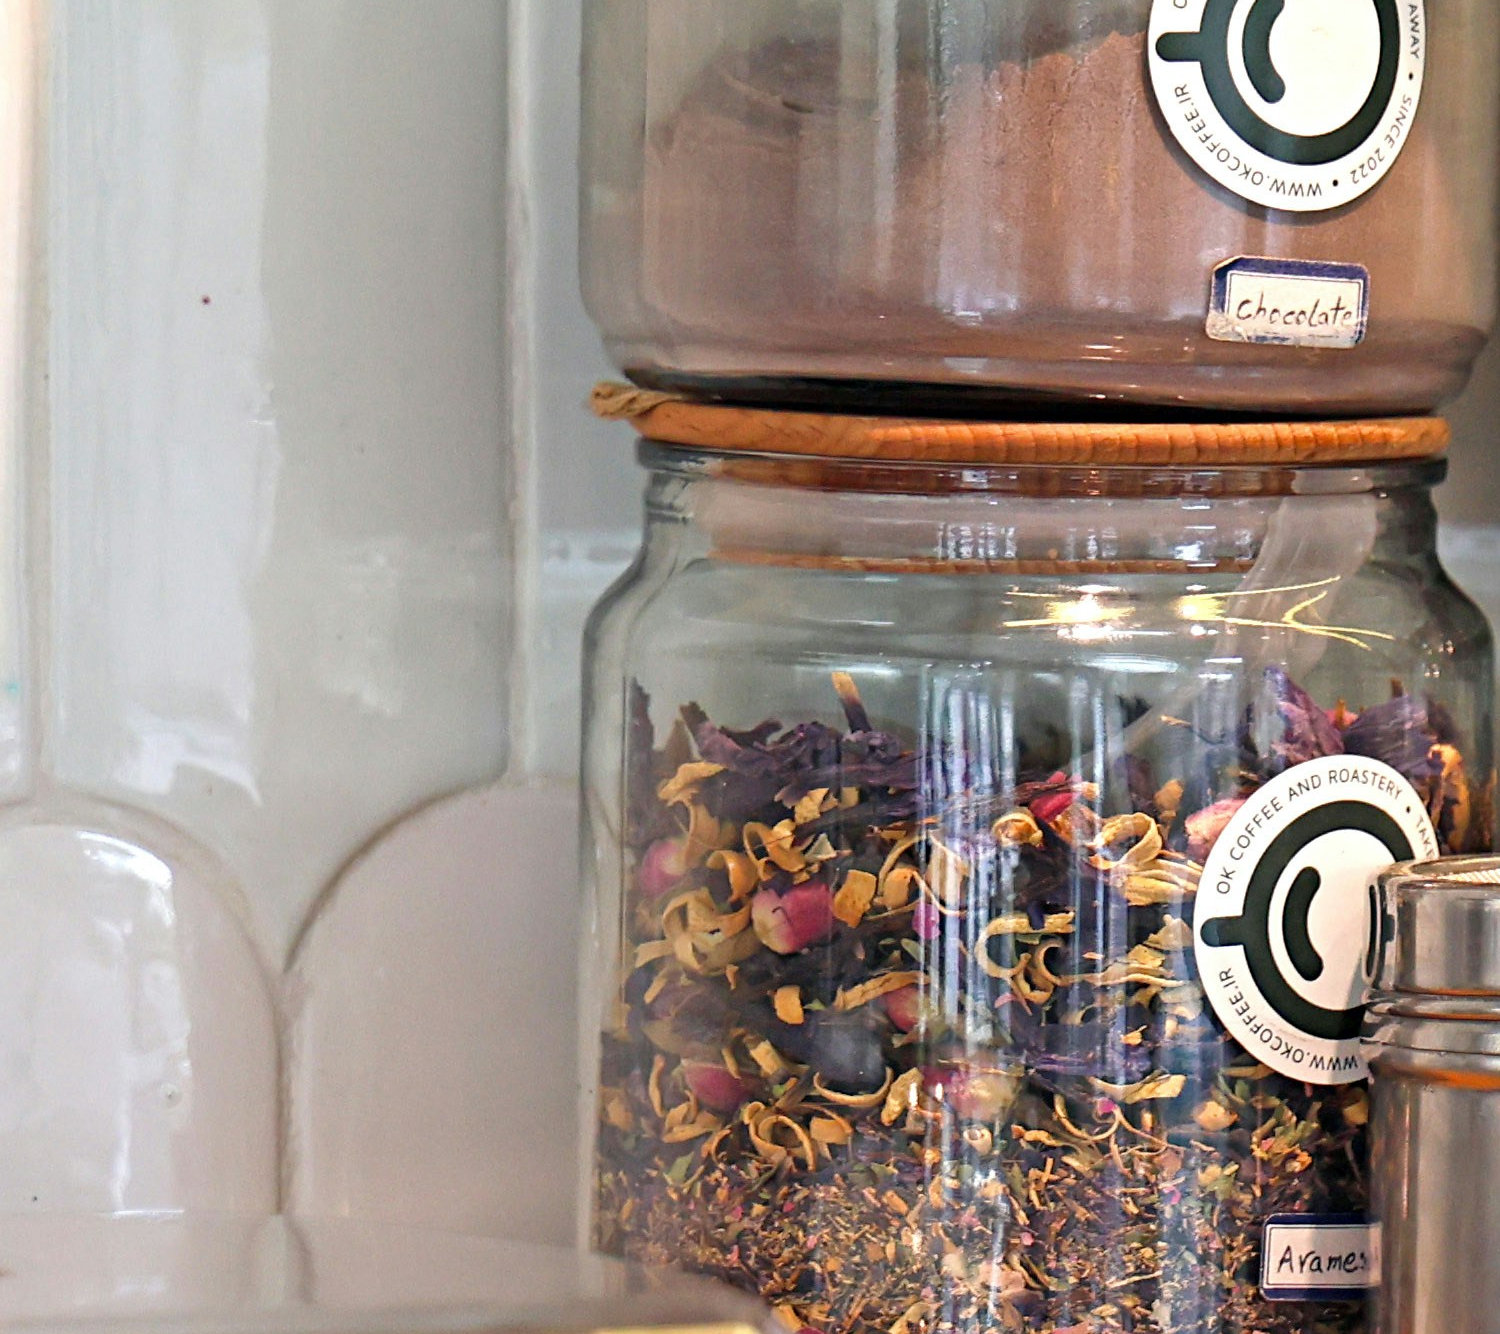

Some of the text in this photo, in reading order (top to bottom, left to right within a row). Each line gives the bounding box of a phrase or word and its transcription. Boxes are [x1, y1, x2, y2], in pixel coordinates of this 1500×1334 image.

[1408, 4, 1420, 59] AWAY
[1174, 84, 1323, 197] WWW.OKCOFFEE.IR
[1349, 94, 1412, 184] SINCE 2022
[1216, 768, 1403, 895] OK COFFEE AND ROASTERY
[1219, 968, 1359, 1072] WWW.OKCOFFEE.IR
